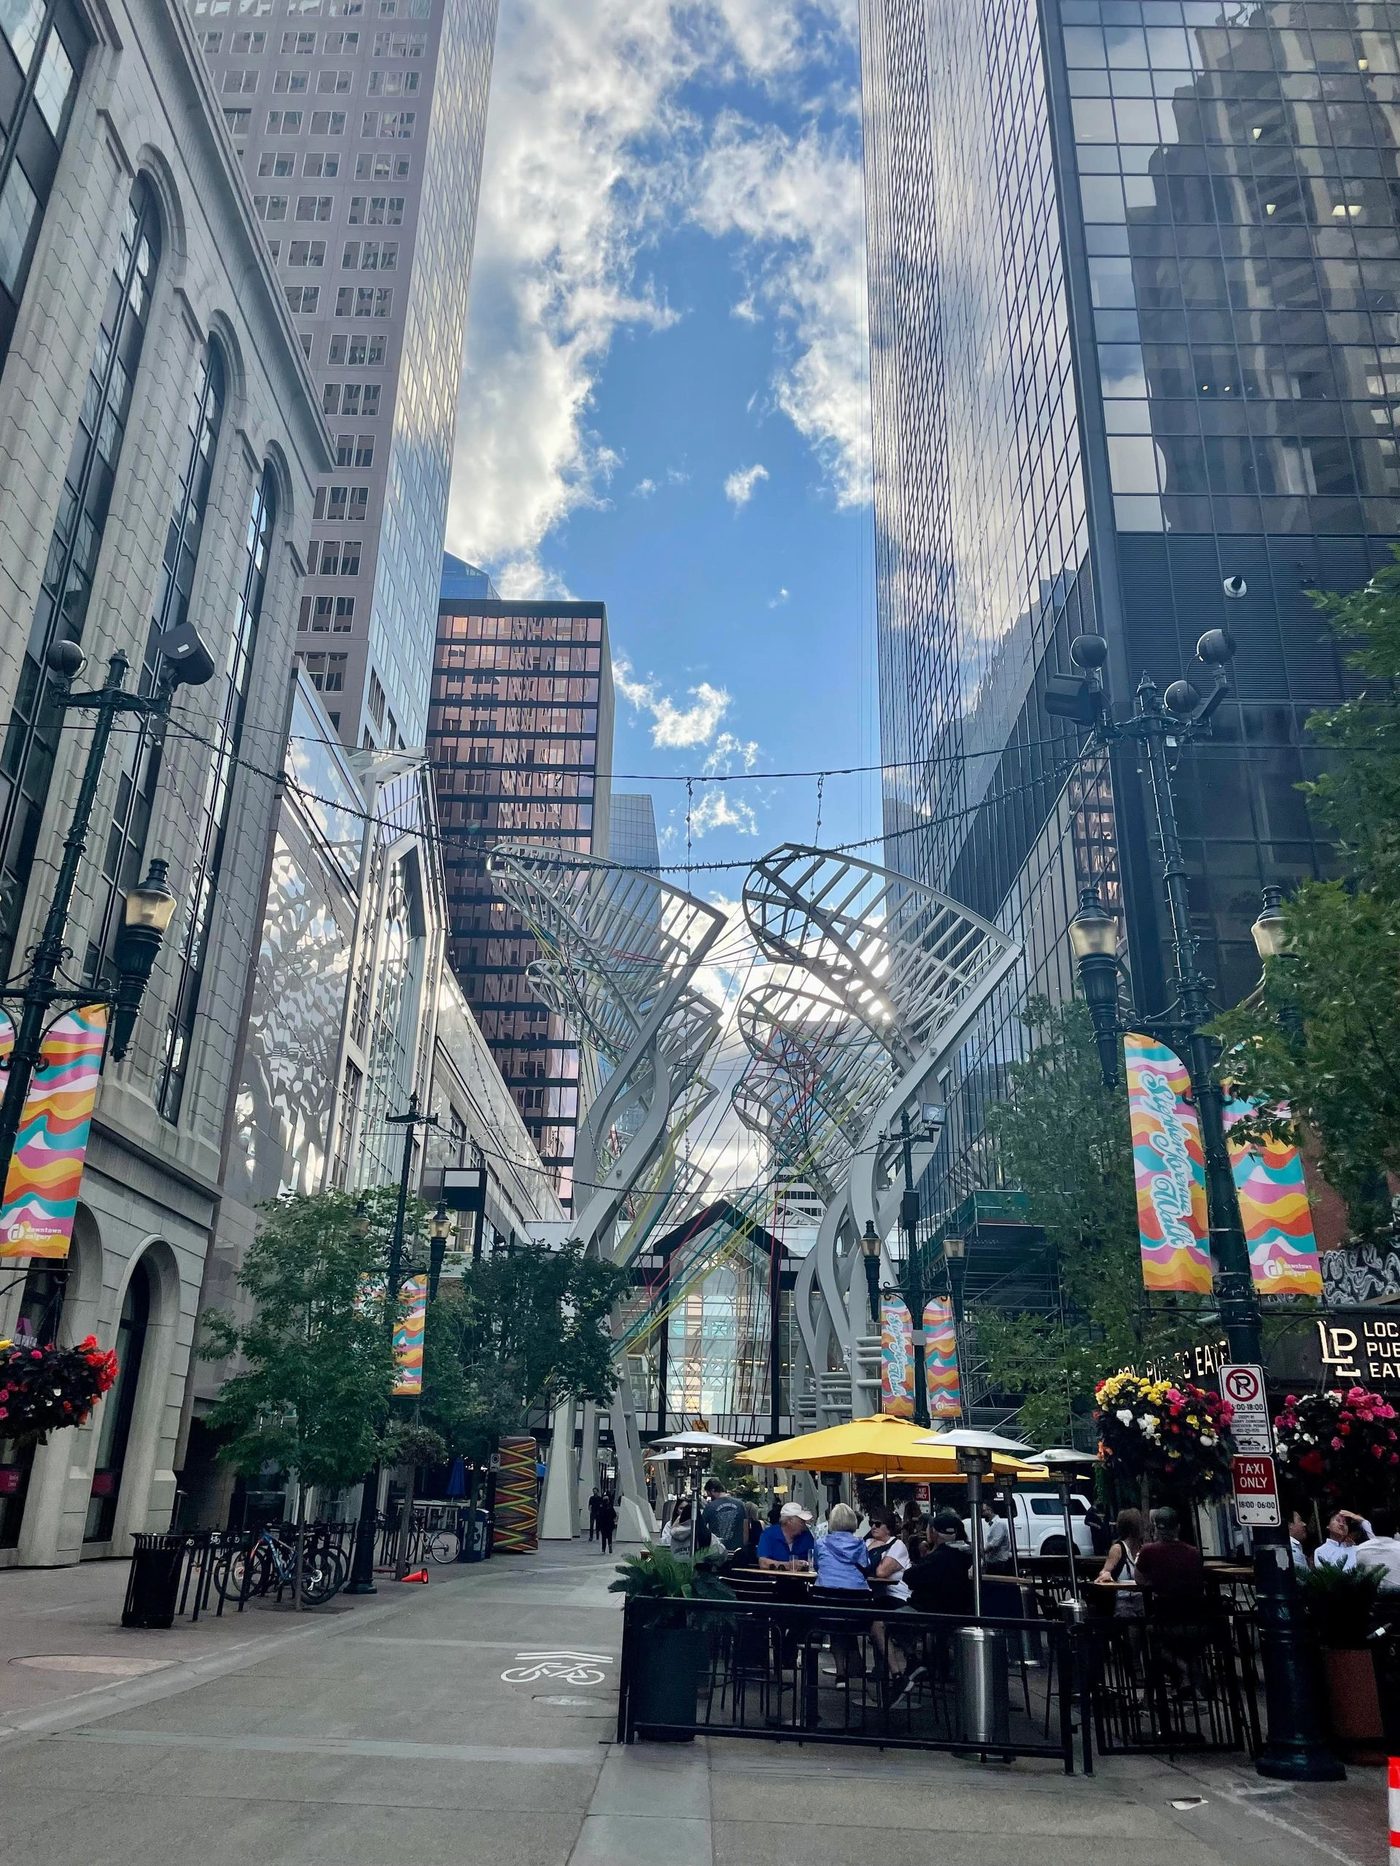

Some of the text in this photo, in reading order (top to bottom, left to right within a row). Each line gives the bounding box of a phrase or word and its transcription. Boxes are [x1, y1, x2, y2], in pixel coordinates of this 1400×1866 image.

[1153, 1177, 1194, 1246] Walk
[1363, 1321, 1399, 1338] LOC
[1238, 1463, 1265, 1475] TAXI
[1239, 1476, 1268, 1489] ONLY
